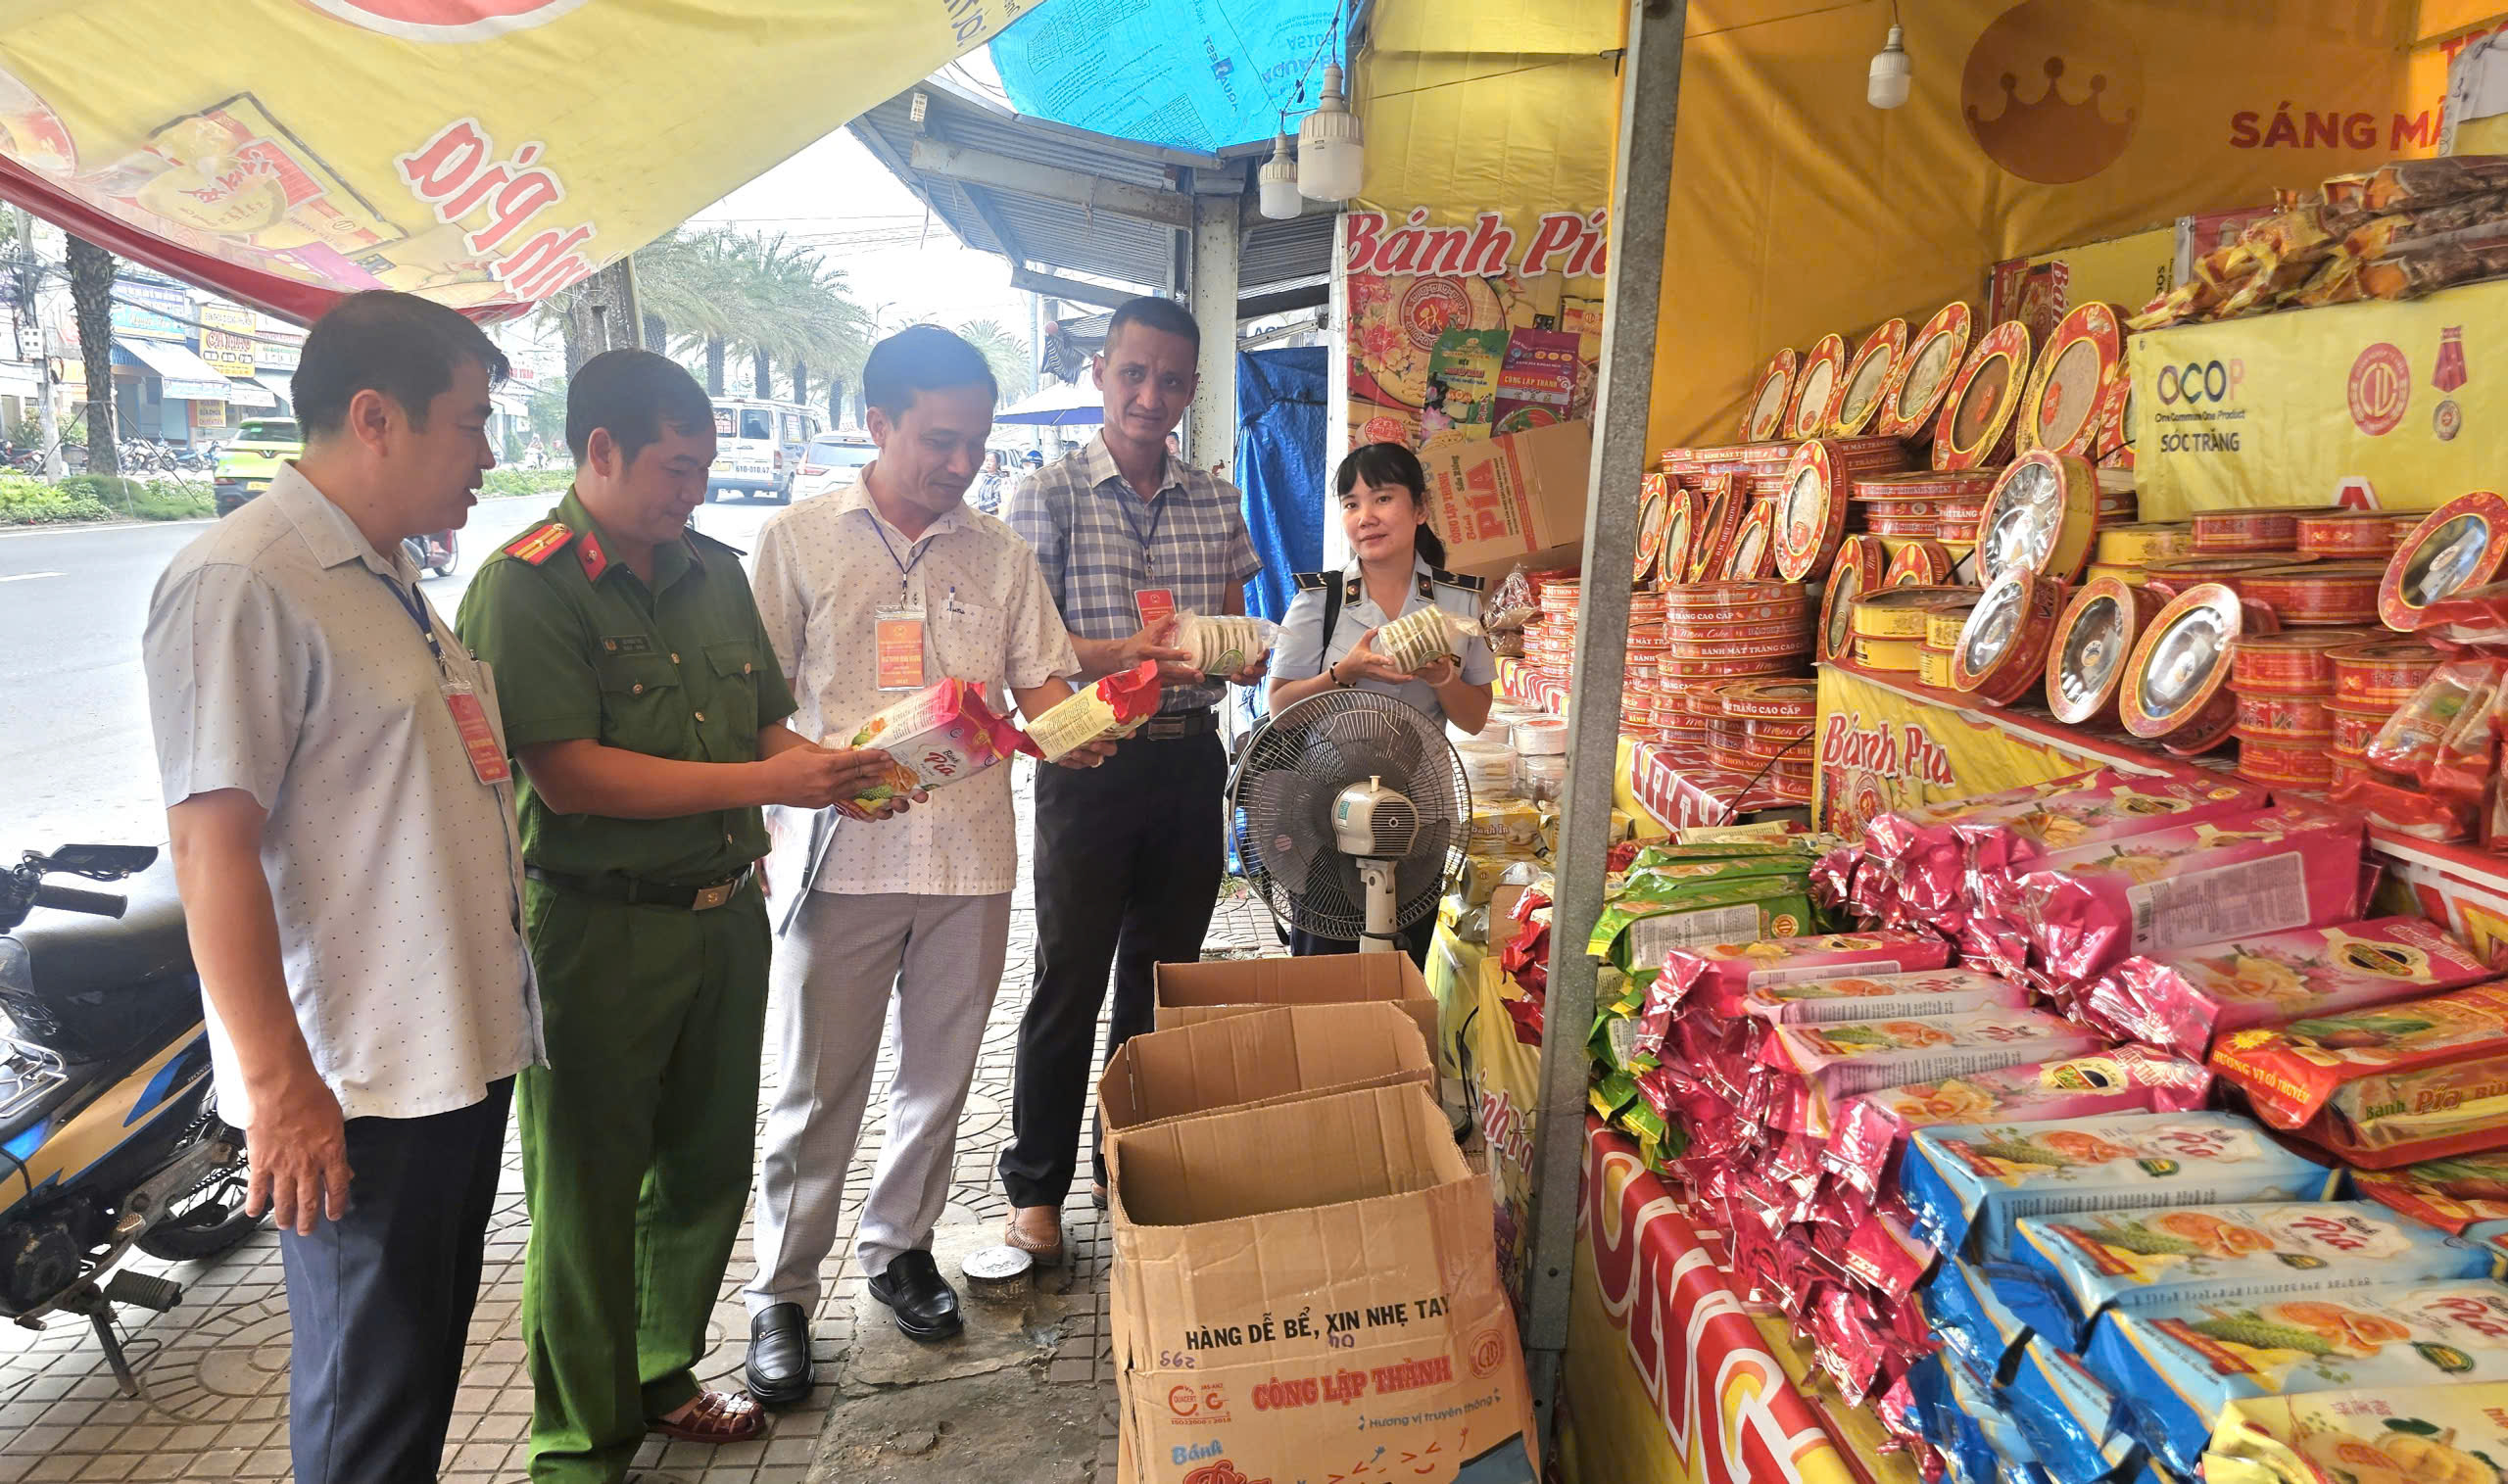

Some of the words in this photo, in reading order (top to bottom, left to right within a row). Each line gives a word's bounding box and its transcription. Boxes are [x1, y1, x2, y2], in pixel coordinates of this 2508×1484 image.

[2229, 100, 2378, 149] SÁNG
[1347, 207, 1516, 277] Bánh
[2157, 359, 2245, 406] OCOP
[2160, 428, 2190, 453] SÓC
[2191, 428, 2241, 453] TRĂNG
[1701, 646, 1725, 655] BÁNH
[1727, 645, 1748, 655] MẶT
[1749, 643, 1779, 654] TRĂNG
[1759, 705, 1778, 714] CAO
[1780, 703, 1802, 715] CẤP
[1822, 711, 1898, 777] Bánh
[1905, 723, 1955, 788] Pía
[2366, 1099, 2406, 1120] Bánh
[2414, 1083, 2463, 1116] Pía
[1185, 1322, 1242, 1350] HÀNG
[1248, 1311, 1276, 1343] DỄ
[1325, 1312, 1360, 1335] XIN
[1367, 1301, 1409, 1325] NHẸ
[1413, 1293, 1452, 1319] TAY
[1252, 1375, 1320, 1412] CÔNG
[1322, 1368, 1369, 1408] LẬP
[1372, 1356, 1452, 1395] THÀNH
[1172, 1439, 1224, 1465] Bánh
